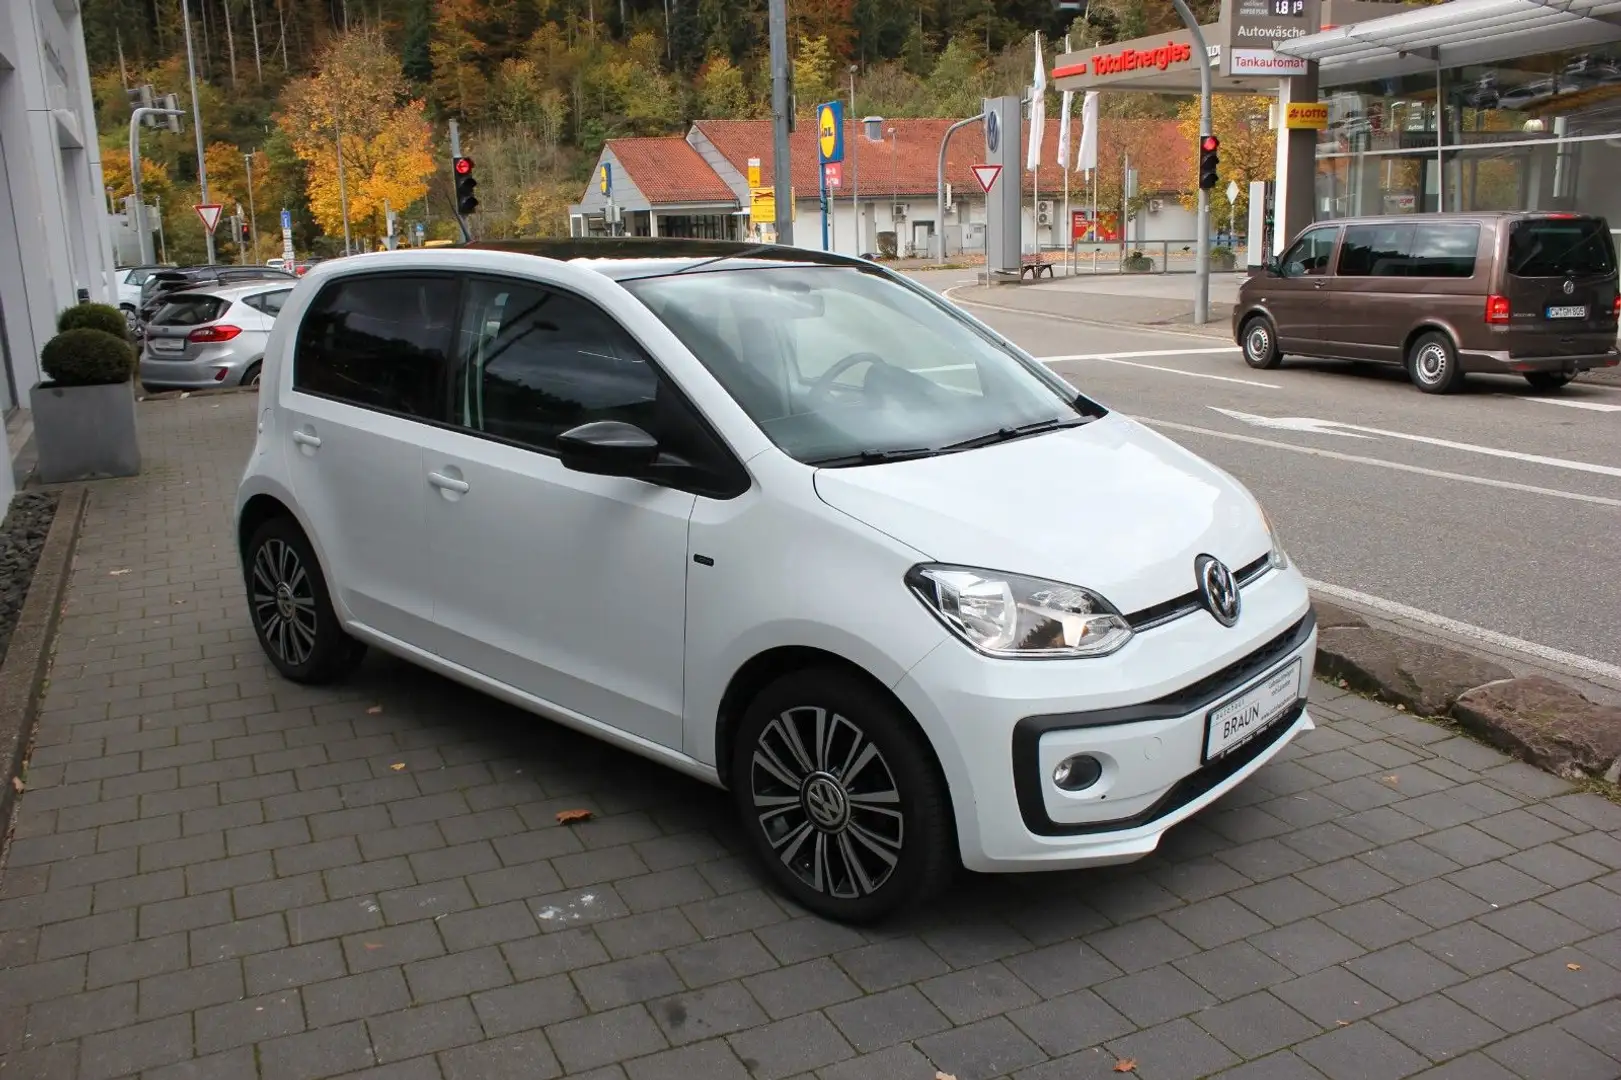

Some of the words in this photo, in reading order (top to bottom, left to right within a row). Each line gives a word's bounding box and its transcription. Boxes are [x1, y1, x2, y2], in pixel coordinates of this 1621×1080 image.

[1237, 25, 1306, 38] Autowäsche
[1092, 40, 1191, 76] TotalEnergies
[1235, 56, 1305, 69] Tankautomat
[1301, 108, 1328, 118] LOTTO
[1223, 702, 1260, 739] BRAUN
